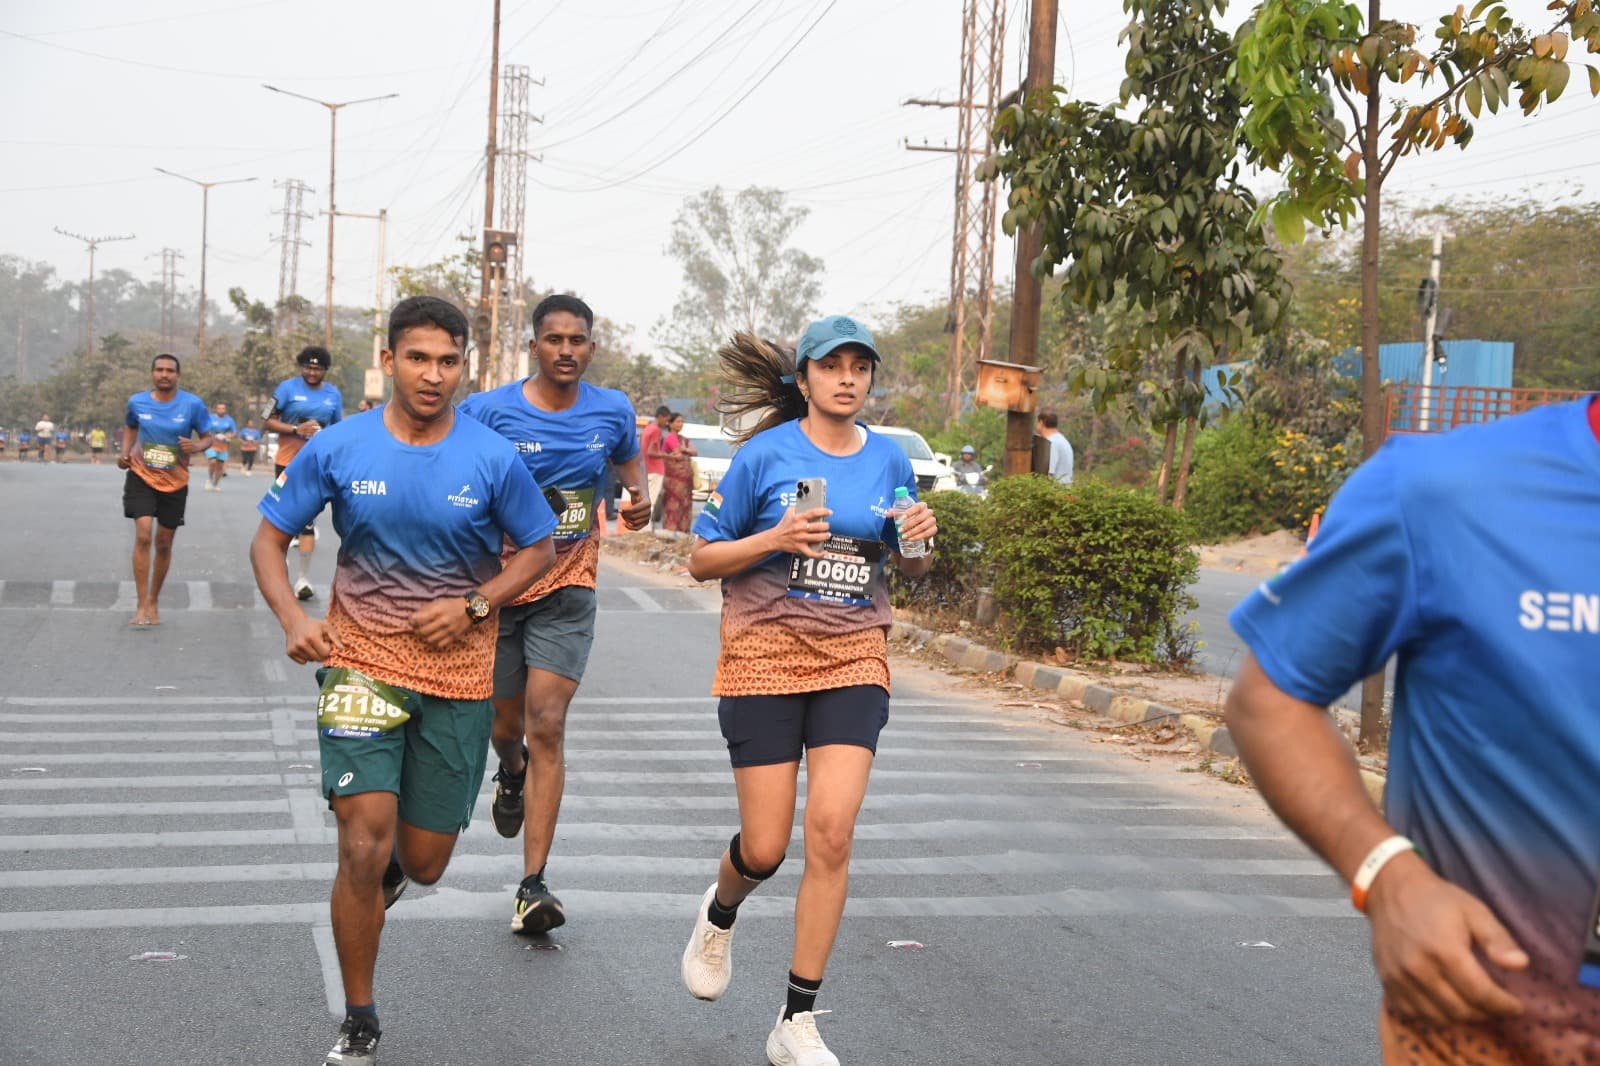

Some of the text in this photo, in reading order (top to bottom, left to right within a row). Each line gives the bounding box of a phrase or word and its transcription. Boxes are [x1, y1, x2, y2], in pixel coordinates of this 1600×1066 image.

[514, 442, 542, 453] SENA
[352, 480, 387, 495] SENA
[780, 492, 797, 507] SE
[560, 508, 586, 523] 180
[803, 558, 871, 584] 10605
[1519, 590, 1600, 634] SEN
